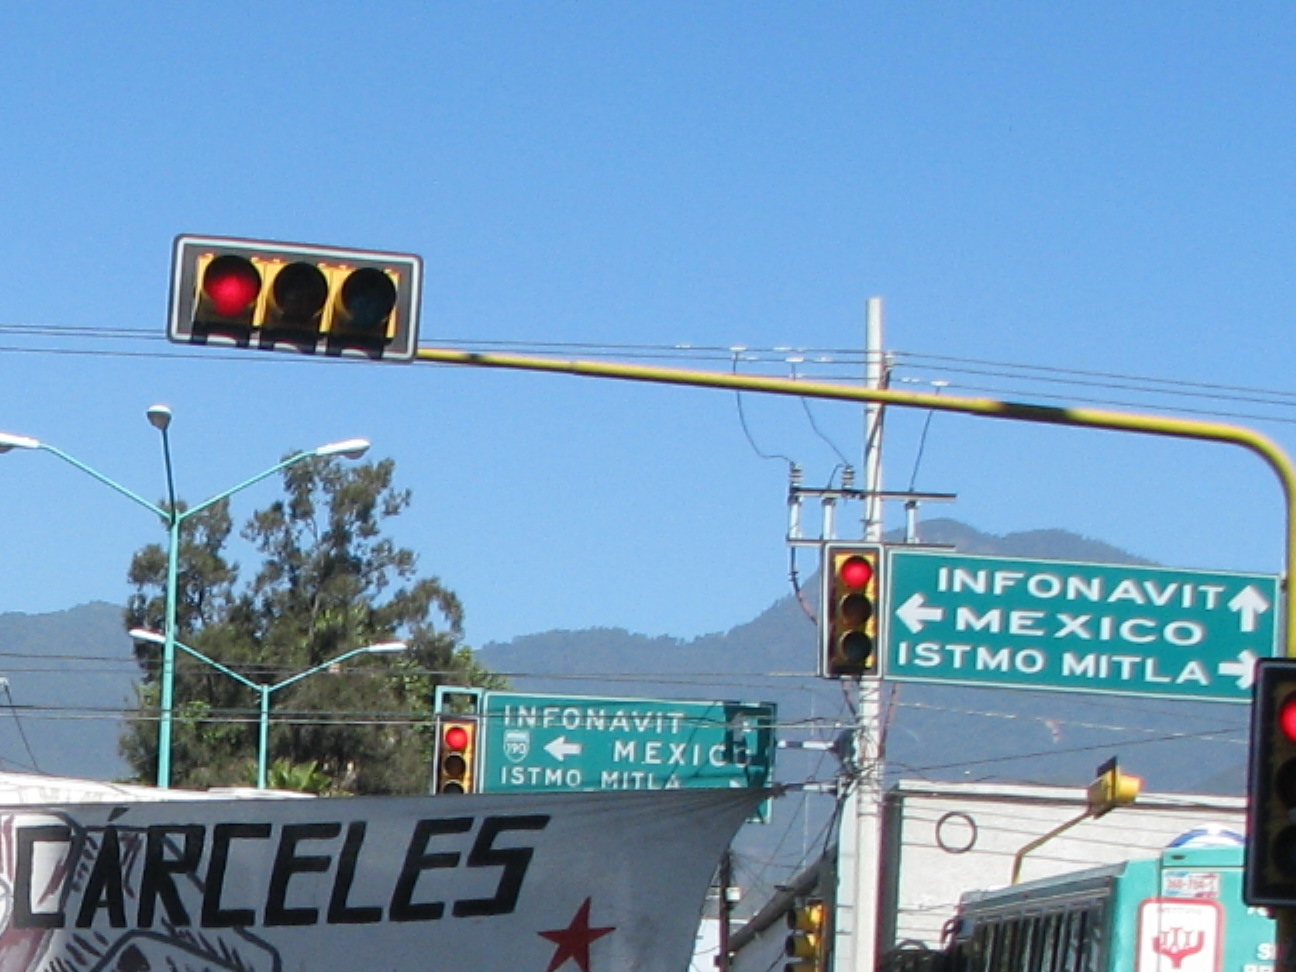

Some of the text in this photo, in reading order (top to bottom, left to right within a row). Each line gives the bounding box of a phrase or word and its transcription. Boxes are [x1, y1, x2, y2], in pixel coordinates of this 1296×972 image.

[938, 567, 1224, 610] INFONAVIT
[955, 606, 1204, 646] MEXICO
[898, 641, 1210, 685] ISTMO MITLA
[504, 704, 685, 734] INFONAVIT
[501, 766, 682, 790] ISTMO MITLA
[14, 806, 551, 930] CÁRCELES
